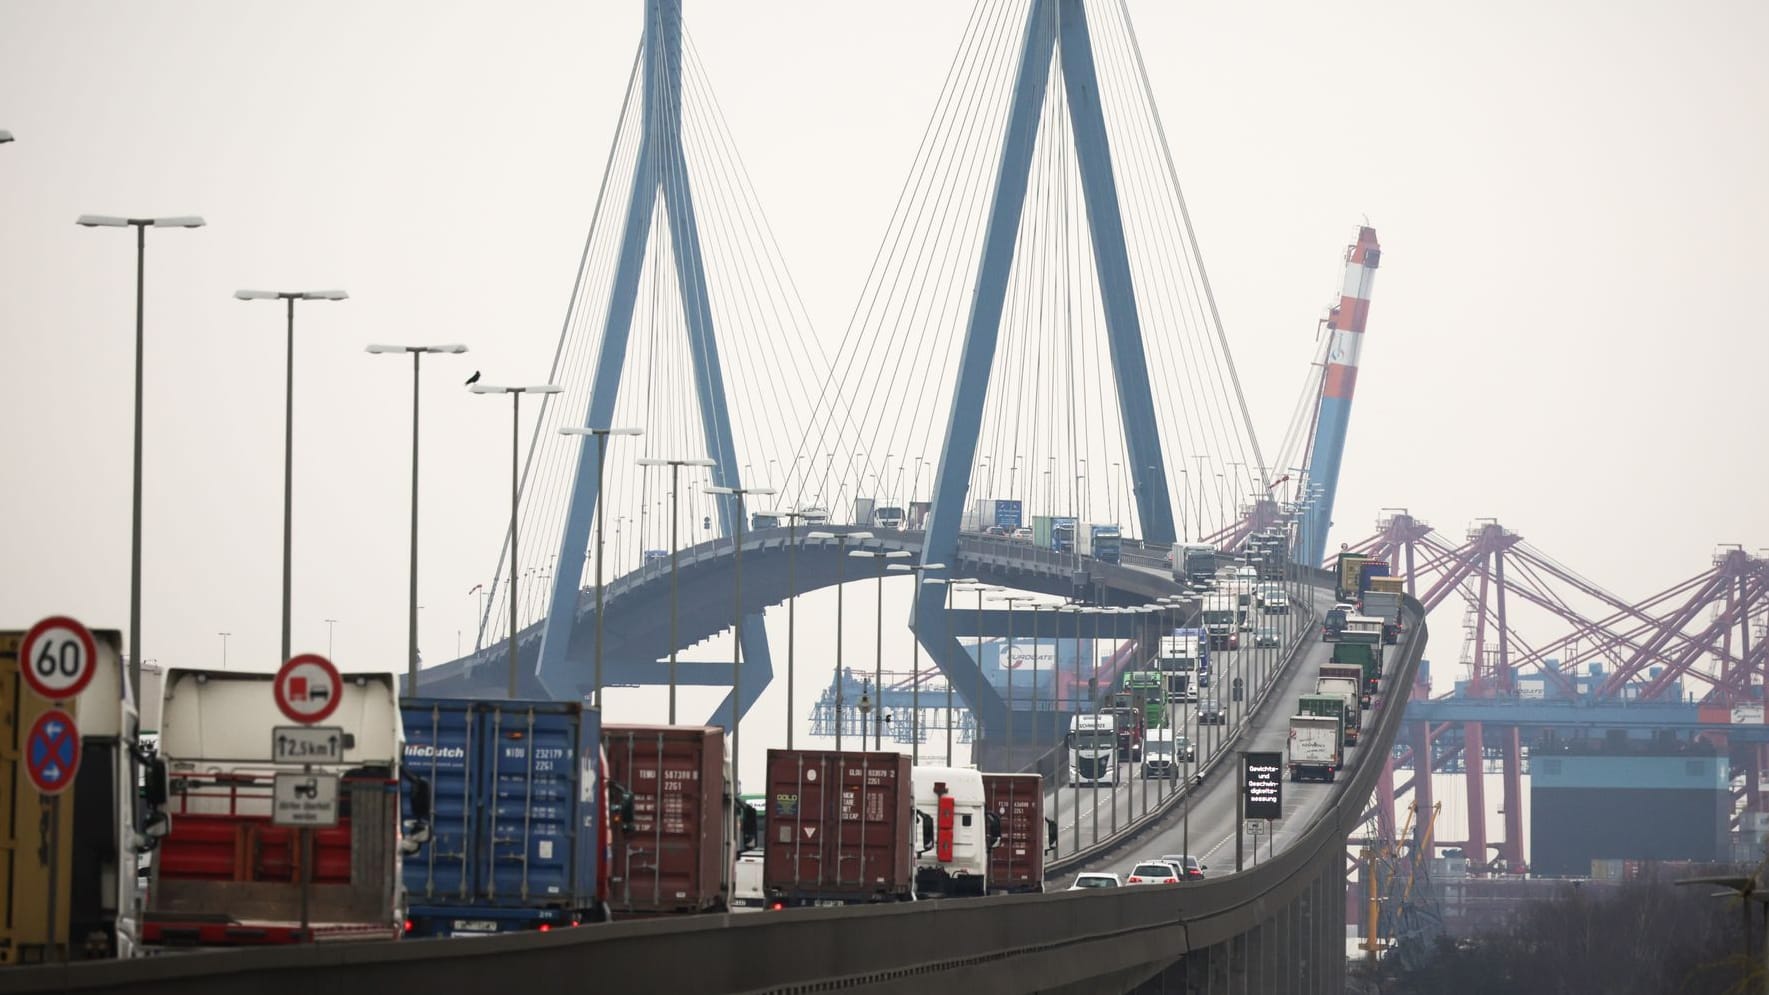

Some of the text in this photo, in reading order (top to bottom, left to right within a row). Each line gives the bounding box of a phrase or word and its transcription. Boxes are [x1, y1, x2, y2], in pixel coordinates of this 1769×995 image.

[36, 640, 80, 677] 60
[308, 741, 327, 756] km
[505, 748, 525, 758] NIDU
[535, 748, 563, 759] 232179
[535, 761, 553, 771] 22G1
[890, 770, 895, 778] 2
[664, 781, 682, 791] 22G1
